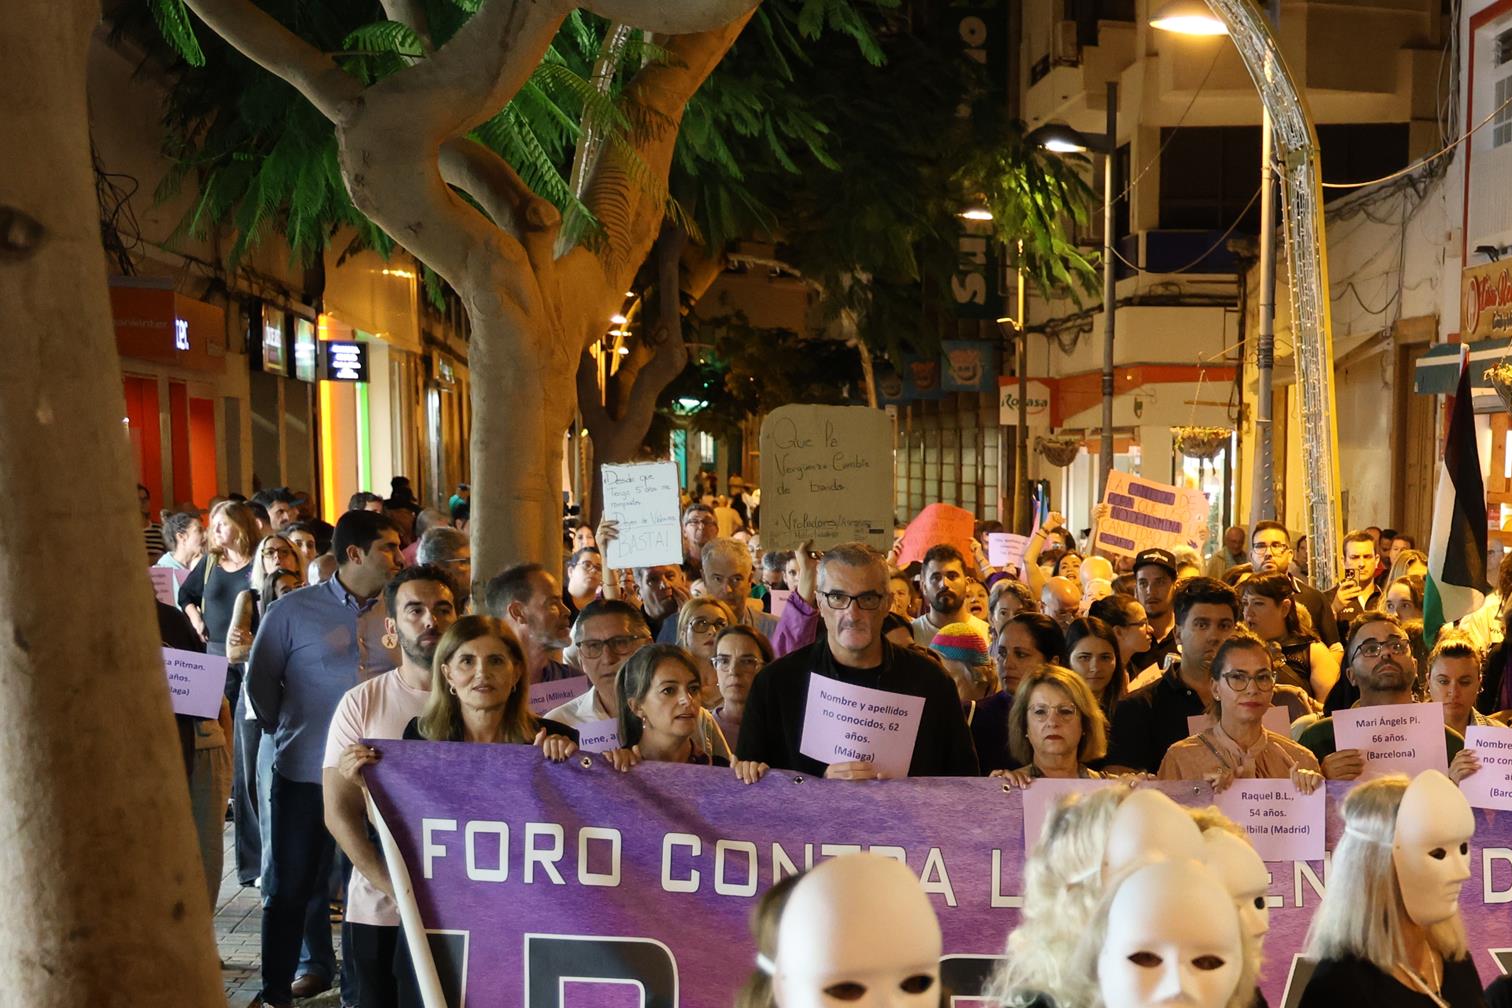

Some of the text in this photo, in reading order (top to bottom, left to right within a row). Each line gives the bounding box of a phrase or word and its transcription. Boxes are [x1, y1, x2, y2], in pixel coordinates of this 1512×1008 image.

[820, 690, 909, 717] Nombre y apellidos
[822, 708, 900, 732] no conocidos, 62
[1356, 716, 1420, 728] Mari Ángels Pi.
[581, 735, 609, 746] Irene,
[844, 731, 871, 744] años.
[1372, 733, 1408, 743] 66 años.
[1475, 739, 1512, 750] Nombre
[834, 745, 876, 763] (Málaga)
[1366, 748, 1416, 761] (Barcelona)
[1483, 756, 1495, 764] no
[1241, 792, 1273, 803] Raquel
[1249, 808, 1287, 817] 54 años.
[1270, 824, 1310, 835] (Madrid)
[421, 818, 622, 887] FORO
[661, 831, 959, 907] CONA
